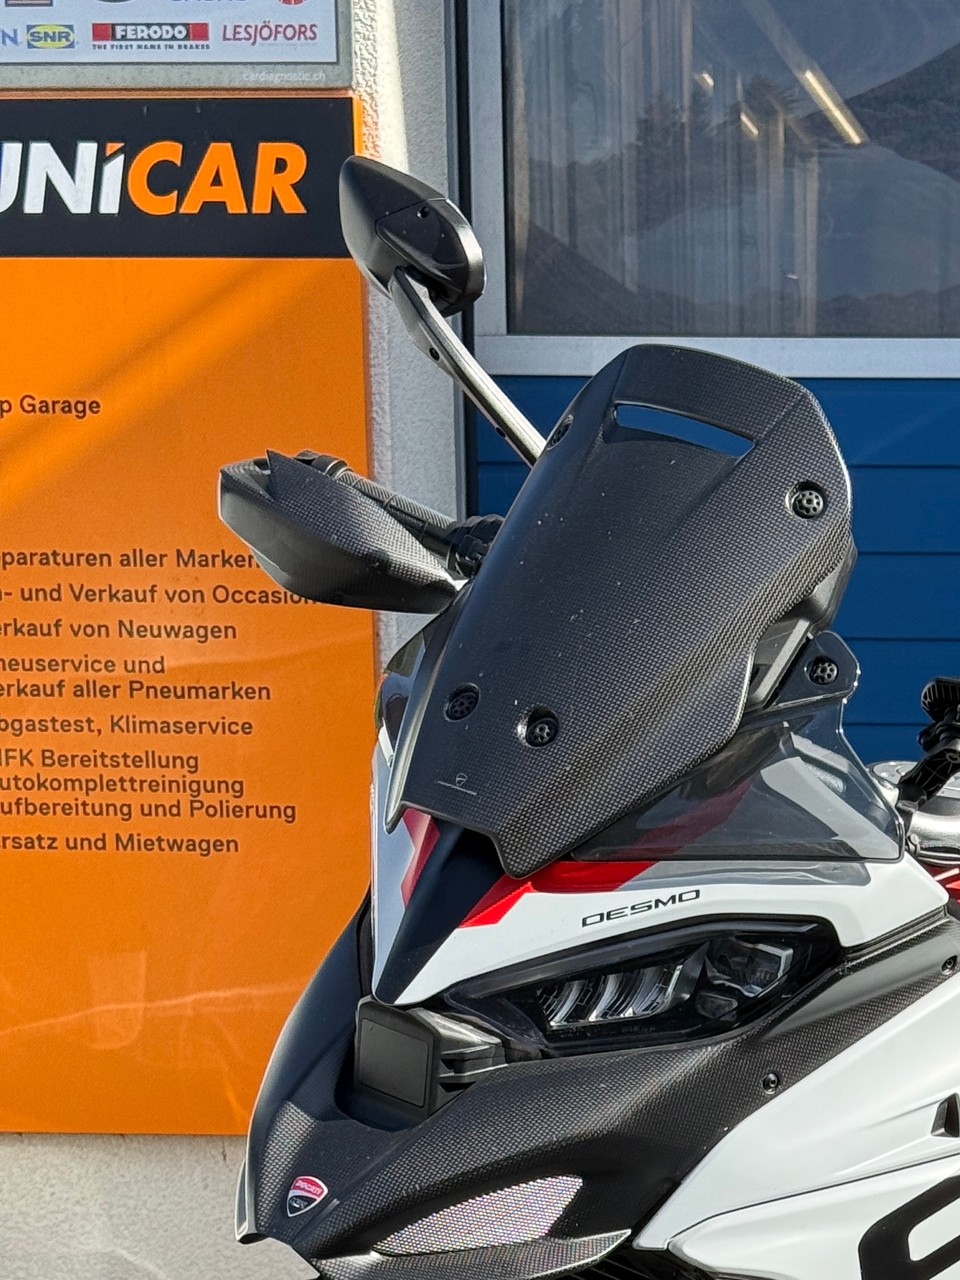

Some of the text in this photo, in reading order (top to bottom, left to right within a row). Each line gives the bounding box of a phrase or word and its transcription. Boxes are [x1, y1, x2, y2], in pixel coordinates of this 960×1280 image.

[29, 31, 71, 43] SNR
[115, 25, 187, 40] FERODO
[222, 20, 318, 46] LESJÖFORS
[20, 395, 100, 419] Garage
[120, 549, 167, 567] aller
[21, 584, 61, 601] und
[70, 584, 157, 602] Verkauf
[165, 590, 204, 603] von
[70, 624, 109, 637] von
[119, 620, 236, 643] Neuwagen
[124, 656, 164, 673] und
[73, 680, 121, 698] aller
[129, 680, 270, 699] Pneumarken
[111, 716, 253, 734] Klimaservice
[41, 750, 199, 774] Bereitstellung
[141, 800, 180, 816] und
[190, 800, 295, 823] Polierung
[66, 834, 106, 850] und
[116, 833, 238, 856] Mietwagen
[581, 889, 701, 928] DESMO
